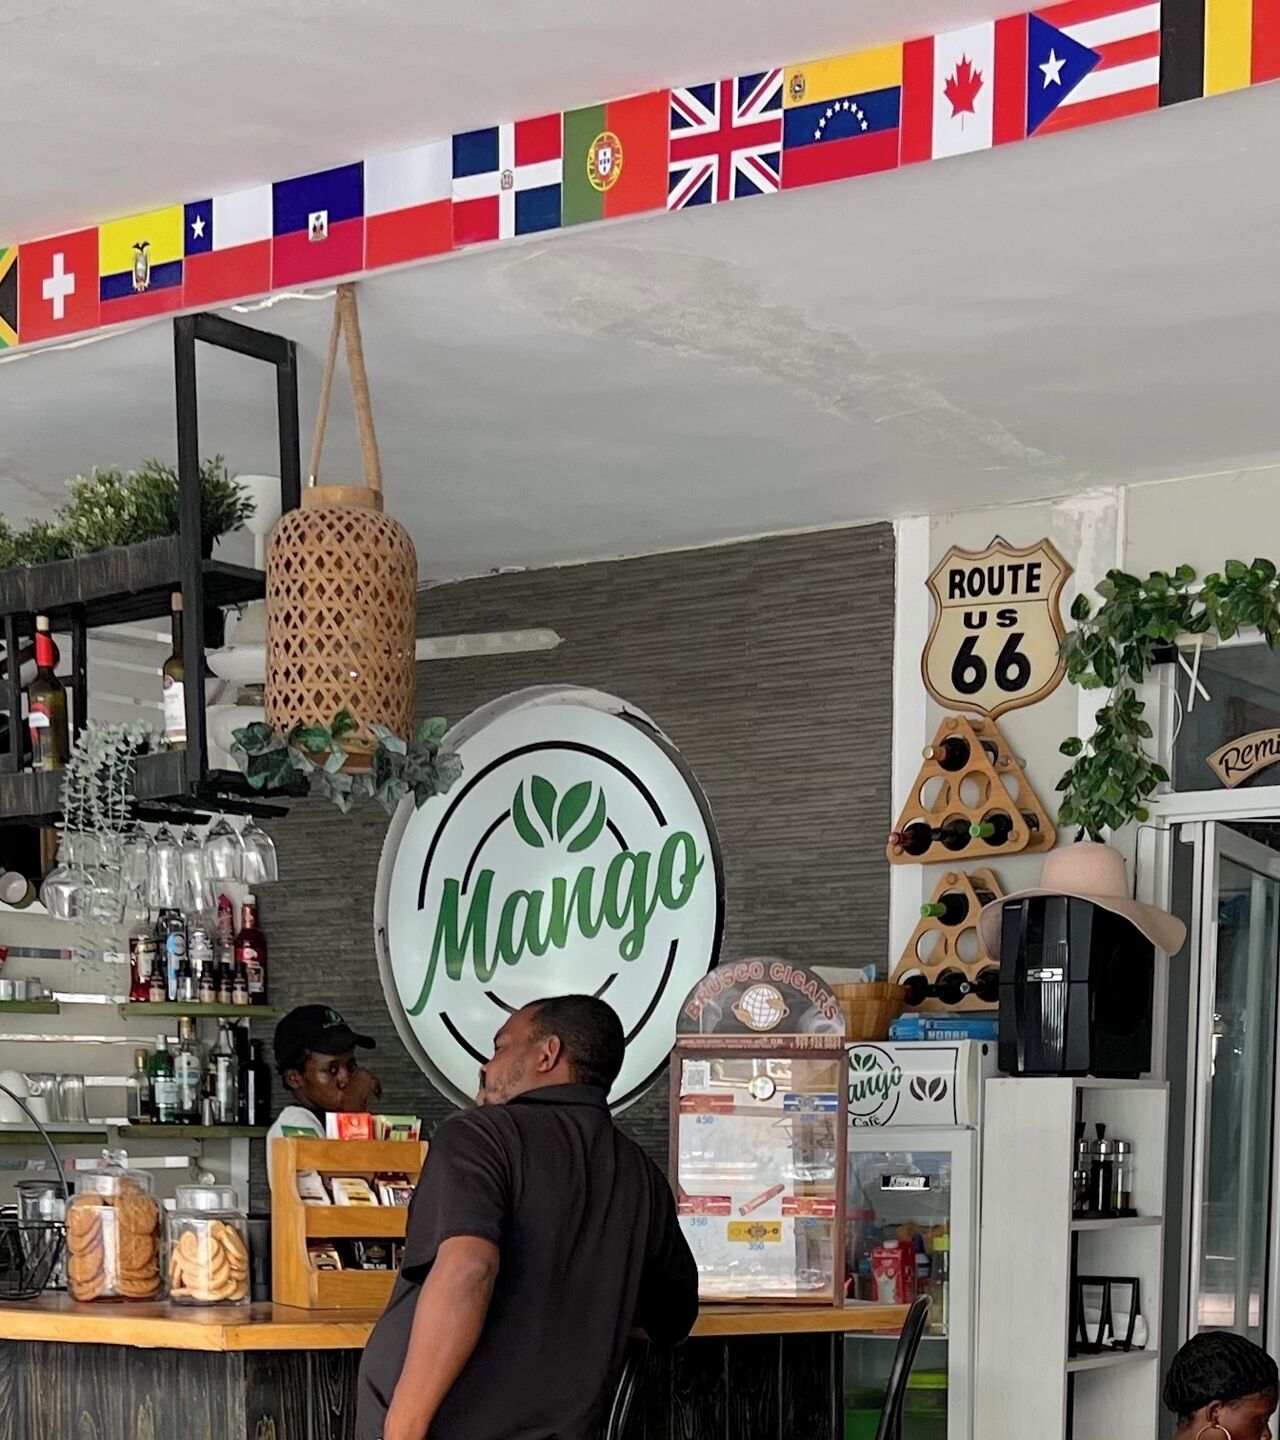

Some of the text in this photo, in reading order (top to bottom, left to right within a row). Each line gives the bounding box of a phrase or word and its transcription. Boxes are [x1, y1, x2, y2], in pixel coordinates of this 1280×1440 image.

[948, 562, 1042, 600] ROUTE
[963, 608, 1018, 630] US
[951, 632, 1031, 695] 66
[406, 830, 706, 1017] Mango
[684, 961, 839, 1021] BRUSCO CIGARS
[848, 1065, 904, 1105] ango
